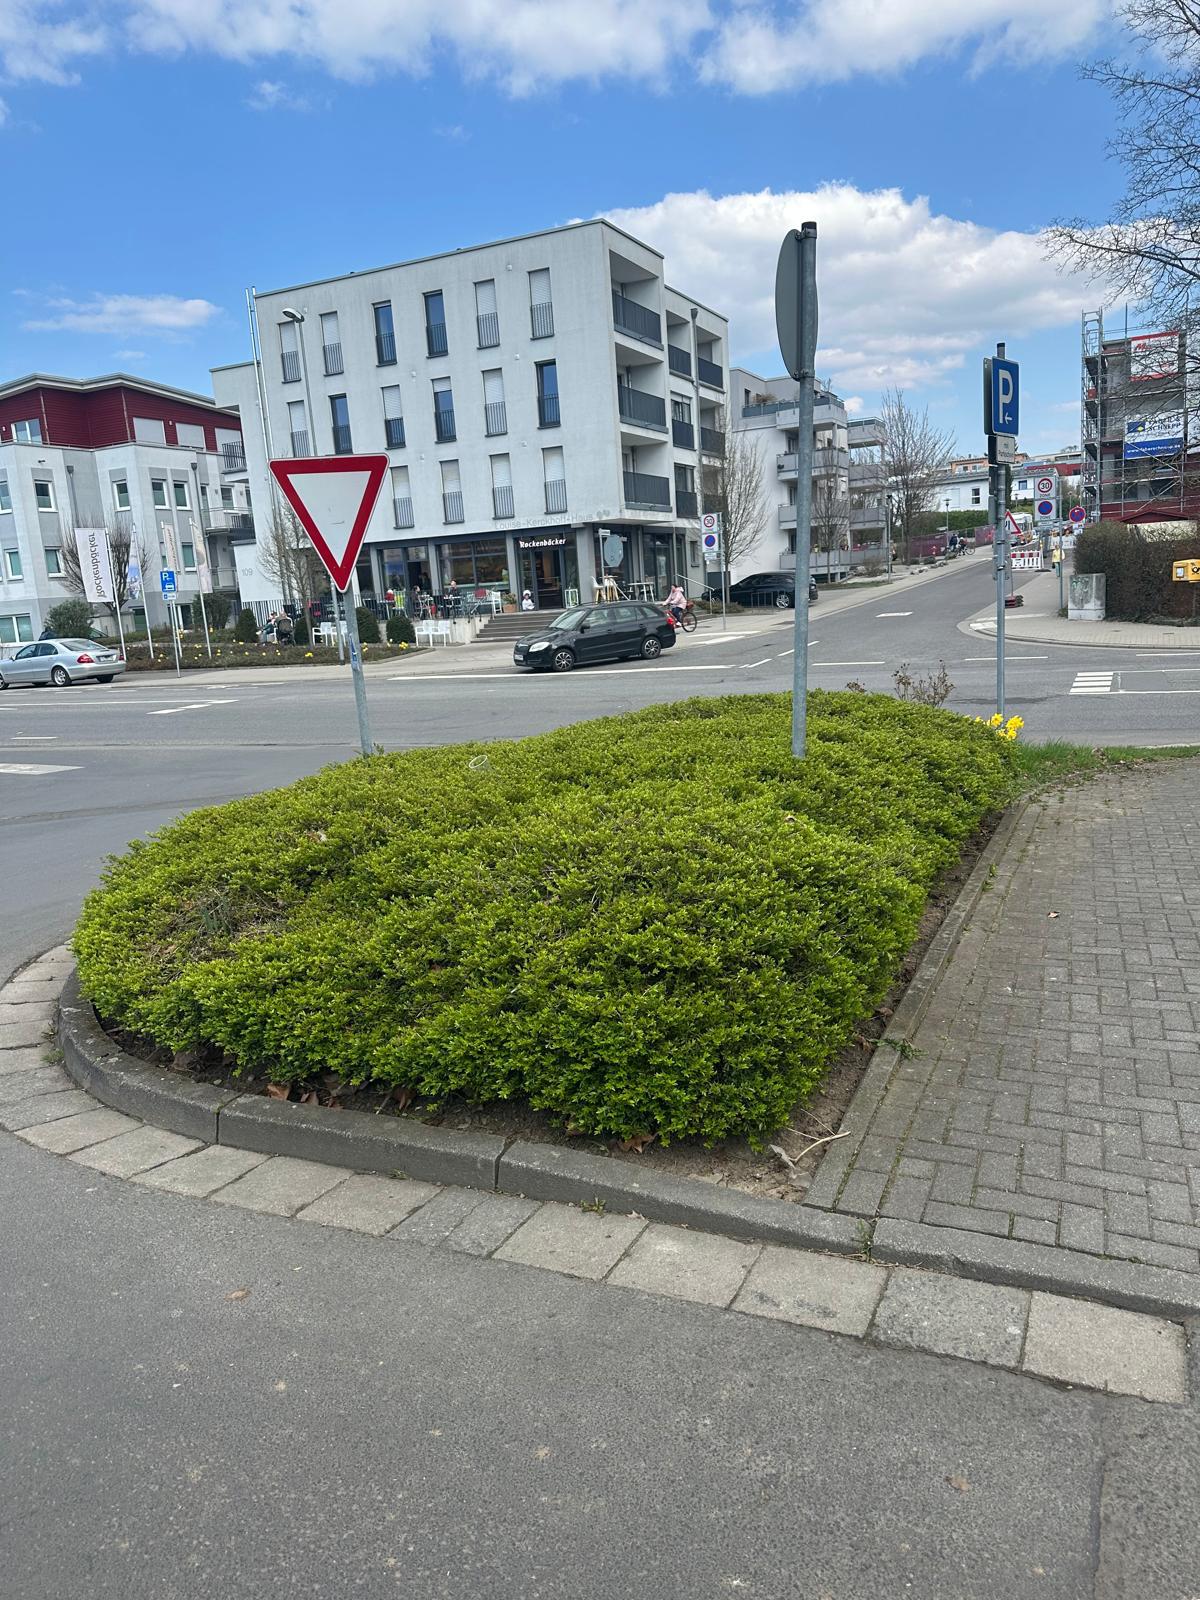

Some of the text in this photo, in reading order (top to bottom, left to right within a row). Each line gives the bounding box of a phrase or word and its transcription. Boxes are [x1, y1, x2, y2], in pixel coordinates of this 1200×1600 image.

[999, 369, 1013, 424] P
[1040, 482, 1050, 490] 30
[519, 537, 567, 549] Rockenbäcker
[162, 573, 169, 581] P
